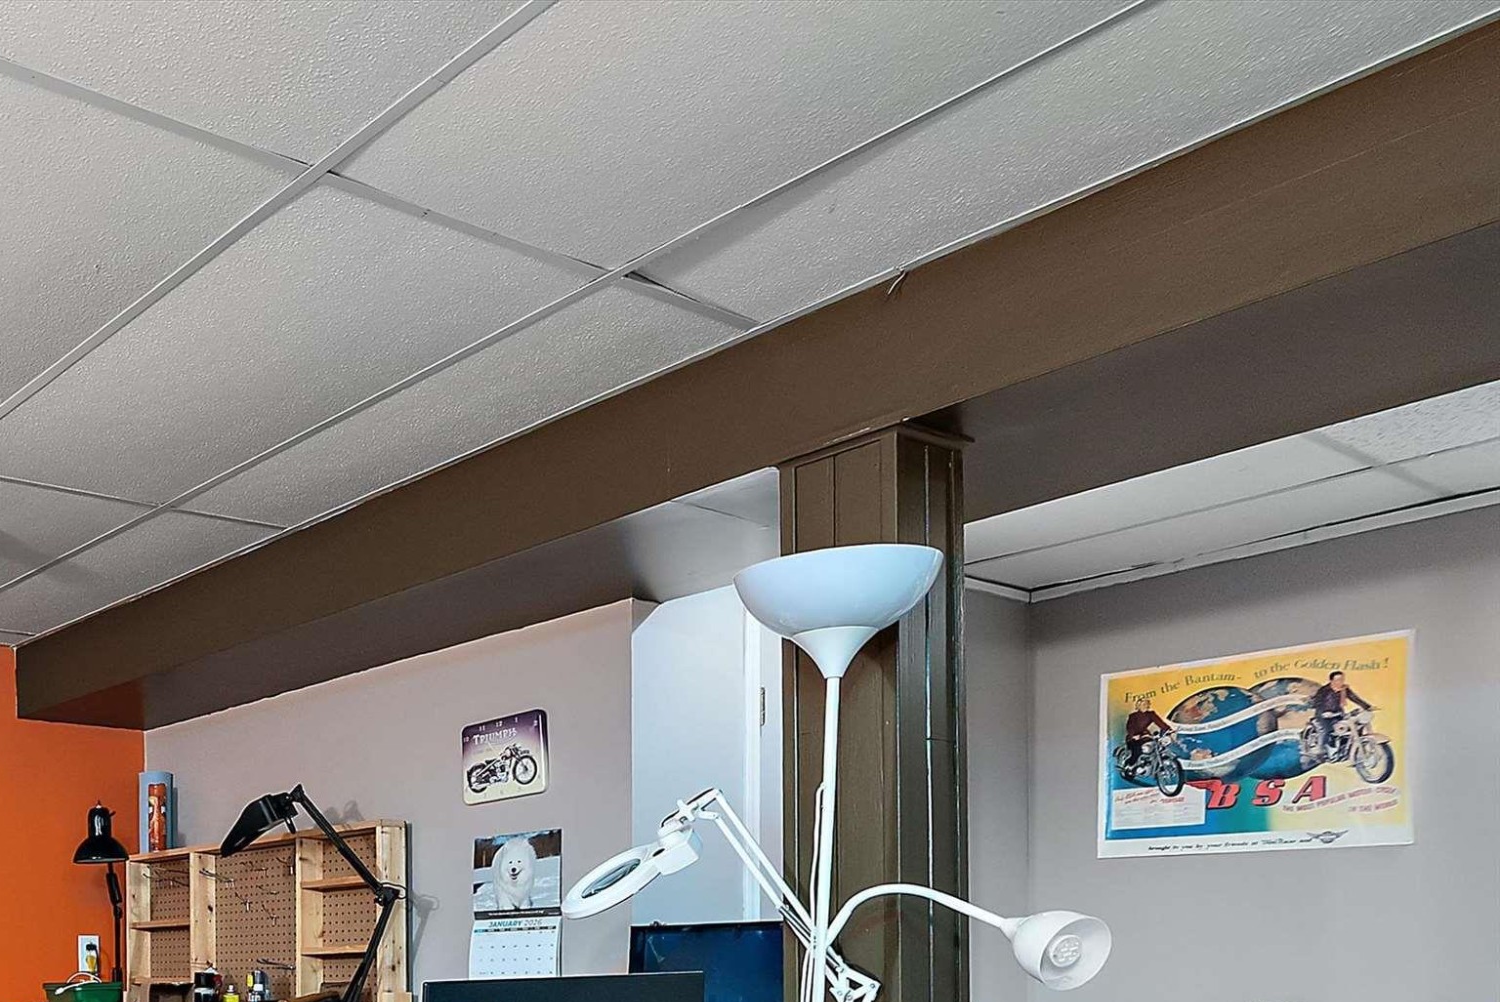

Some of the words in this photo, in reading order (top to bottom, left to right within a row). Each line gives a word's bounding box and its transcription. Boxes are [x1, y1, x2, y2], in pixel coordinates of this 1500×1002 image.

[1124, 690, 1156, 703] From
[1161, 682, 1180, 694] the
[1254, 669, 1267, 679] to
[1270, 662, 1290, 672] the
[1294, 659, 1340, 670] Golden
[472, 727, 518, 745] TRIUMPH
[488, 920, 522, 928] JANUARY
